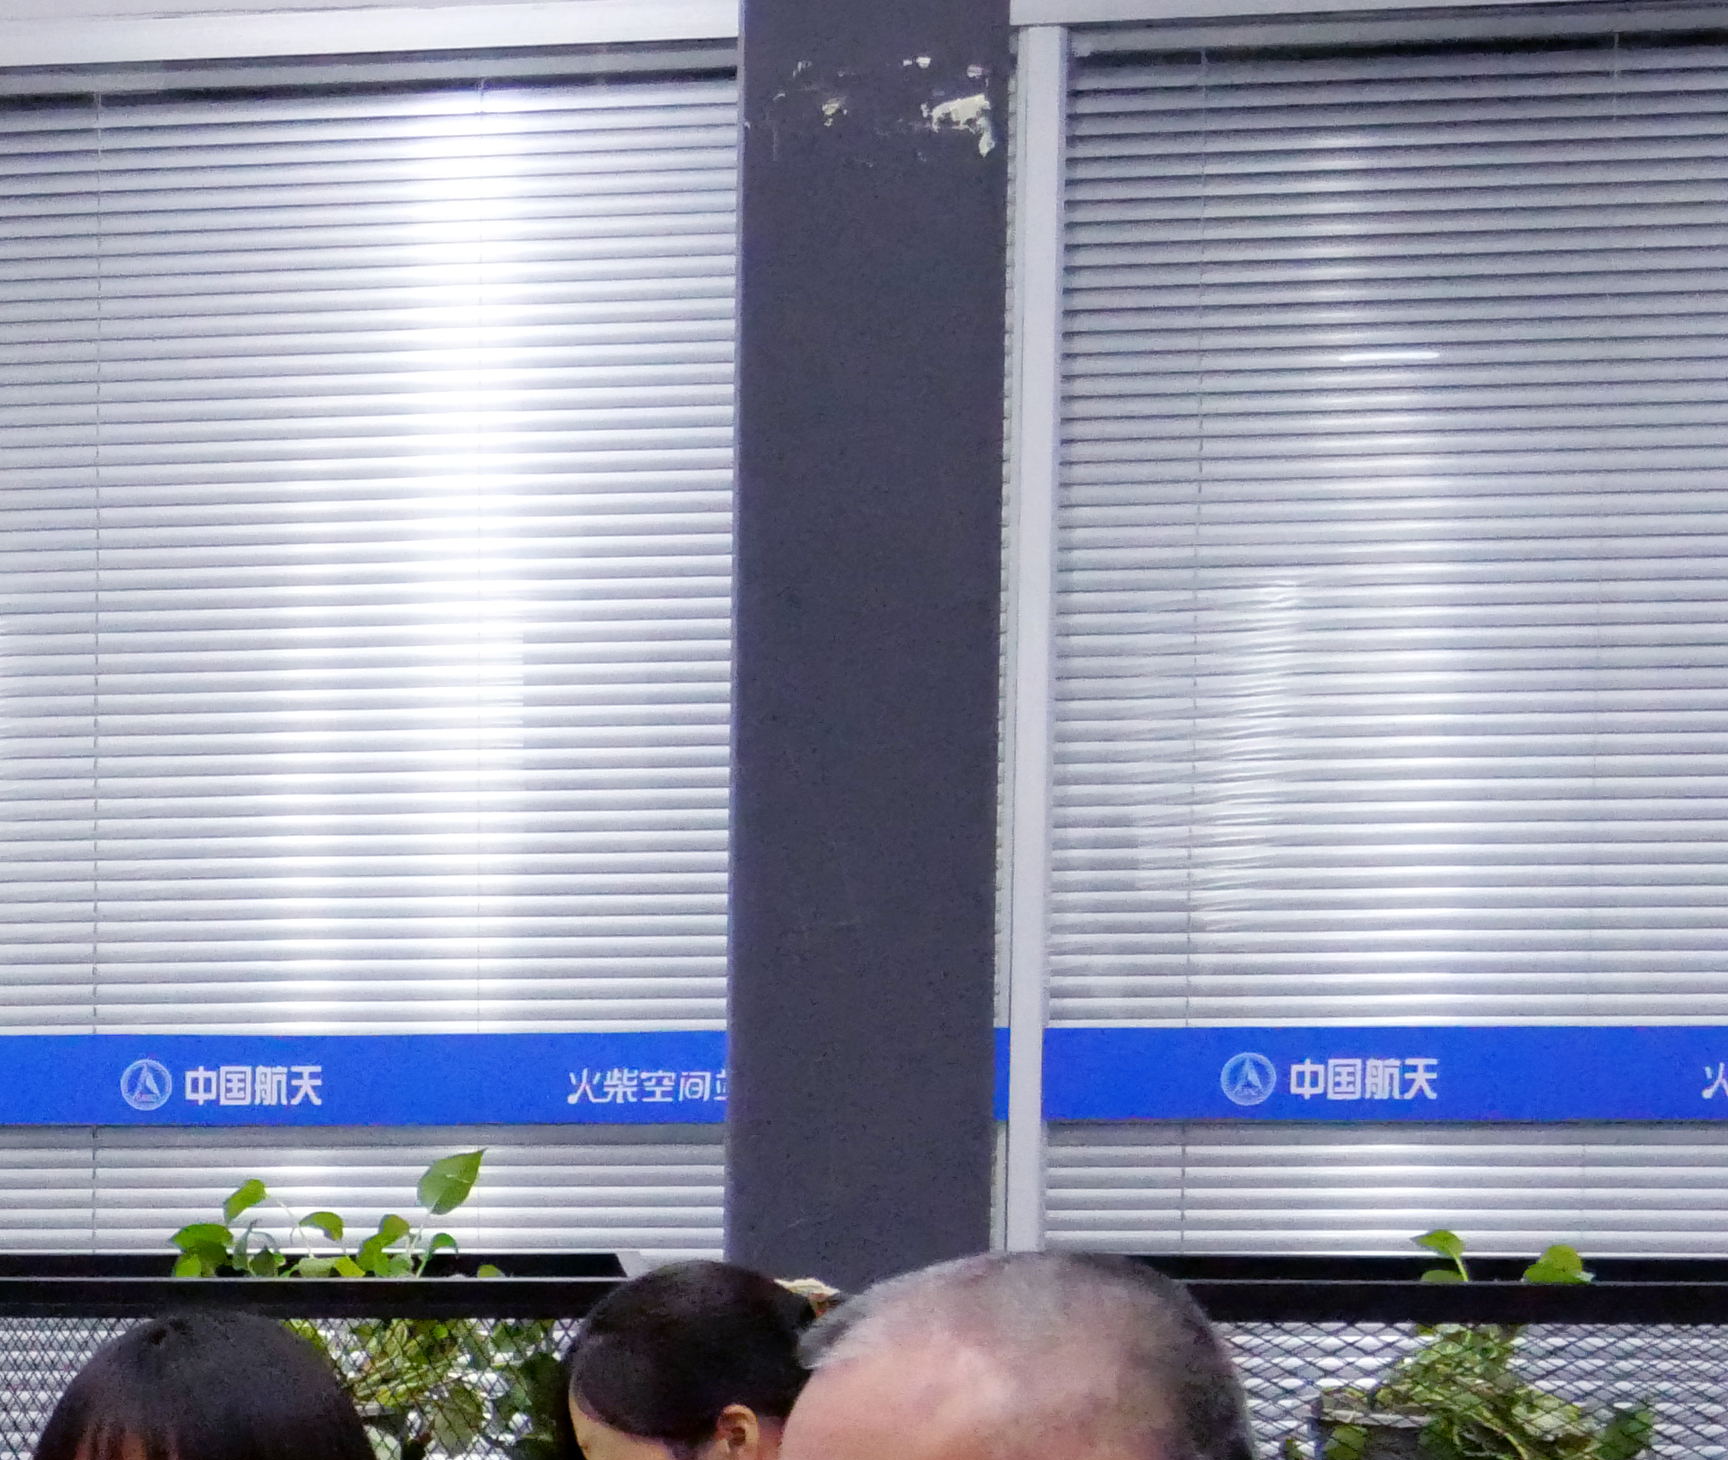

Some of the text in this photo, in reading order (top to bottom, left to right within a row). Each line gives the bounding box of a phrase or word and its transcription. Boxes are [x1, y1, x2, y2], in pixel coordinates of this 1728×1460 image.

[184, 1065, 323, 1106] 中国航天
[1289, 1058, 1438, 1101] 中国航天
